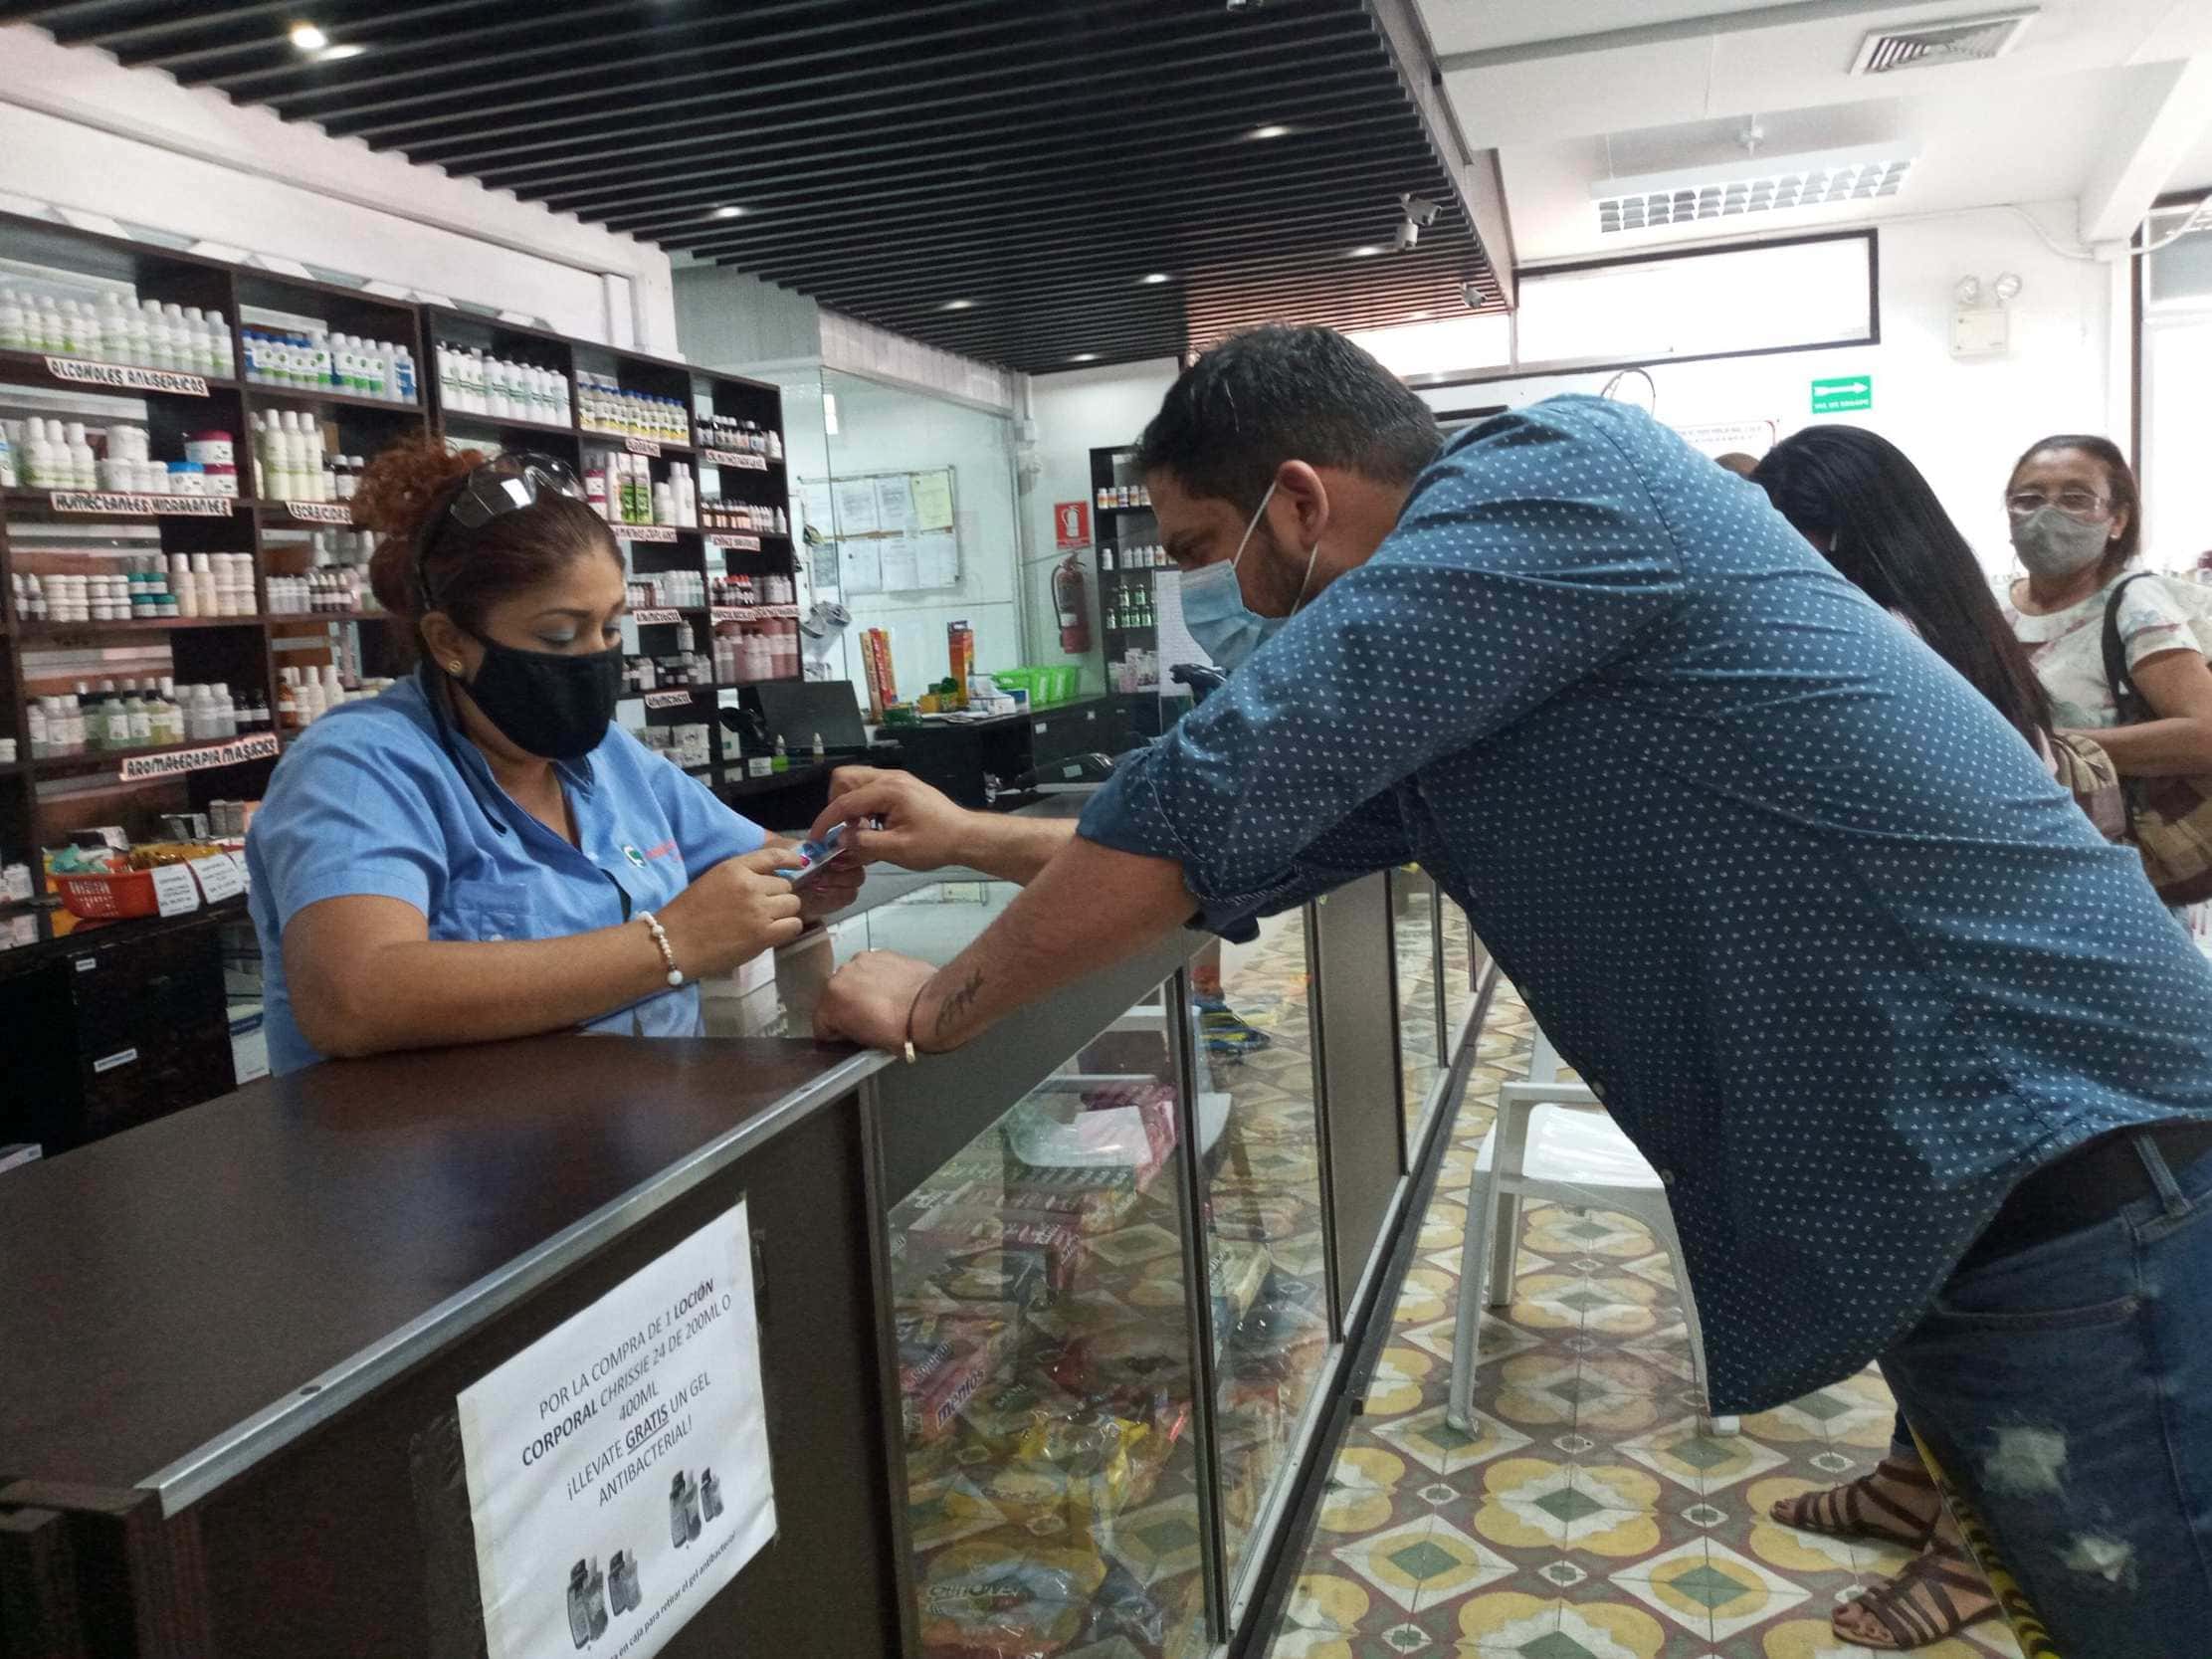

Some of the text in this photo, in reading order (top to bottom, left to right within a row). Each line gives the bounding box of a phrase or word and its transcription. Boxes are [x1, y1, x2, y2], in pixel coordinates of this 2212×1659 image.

[521, 1293, 731, 1467] CORPORAL CHRISSIE 24 DE 200ML O
[538, 1277, 714, 1420] POR LA COMPRA DE 1 LOCIÓN
[619, 1379, 659, 1421] 400ML
[566, 1371, 711, 1501] ¡LLEVATE GRATIS UN GEL
[599, 1415, 694, 1507] ANTIBACTERIAL!
[644, 1610, 661, 1633] para
